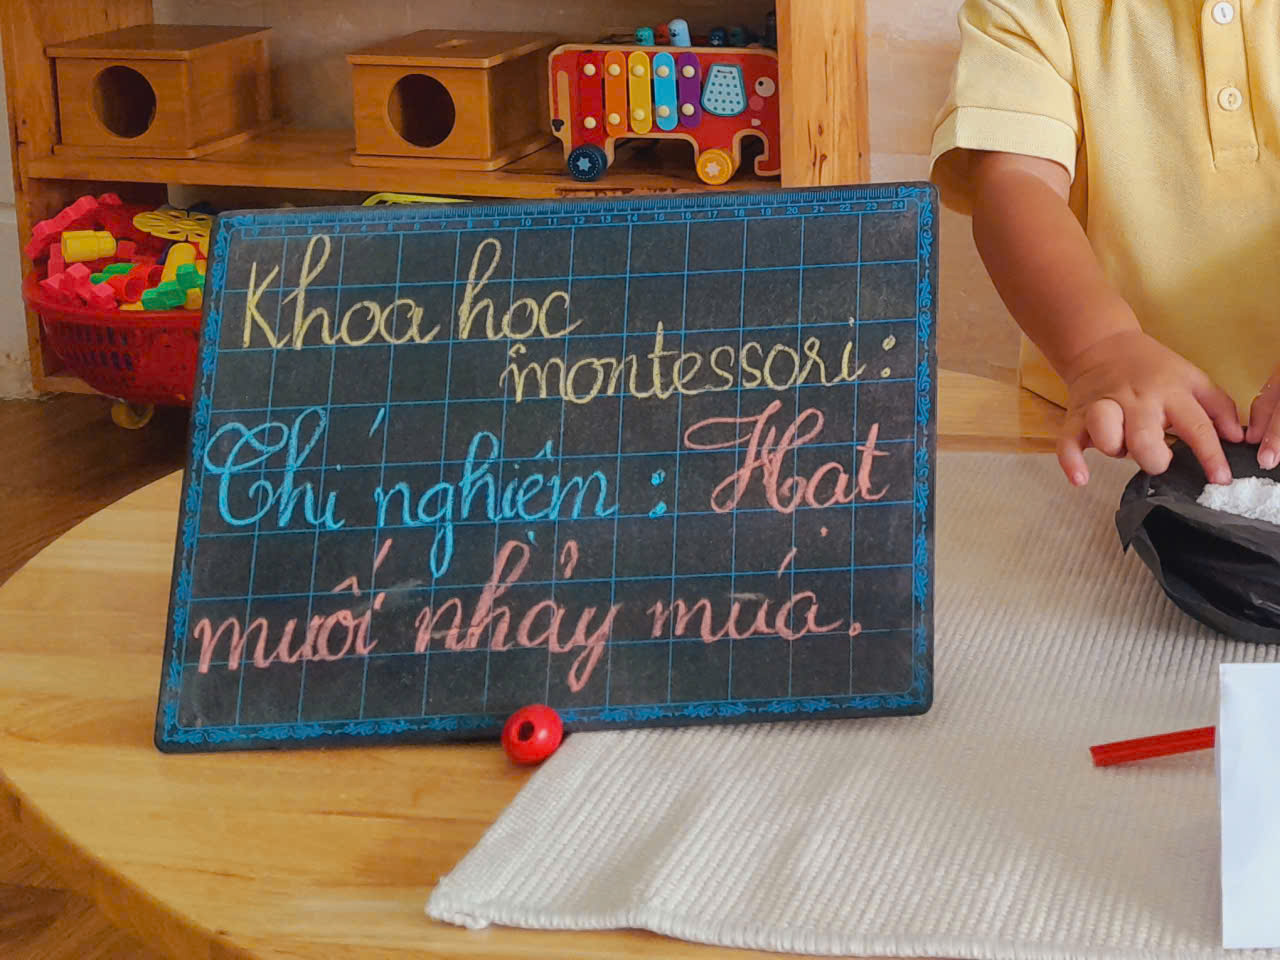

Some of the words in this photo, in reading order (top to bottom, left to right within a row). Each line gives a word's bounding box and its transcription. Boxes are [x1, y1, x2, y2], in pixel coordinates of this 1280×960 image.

[520, 218, 532, 227] 10
[547, 216, 558, 226] 11
[574, 216, 585, 225] 12
[600, 215, 612, 224] 13
[707, 210, 719, 219] 17
[786, 206, 798, 215] 20
[839, 203, 851, 212] 22
[865, 201, 878, 211] 23
[891, 200, 905, 210] 24
[243, 233, 441, 350] Khoa
[193, 538, 393, 674] muối
[415, 539, 623, 693] nhảy
